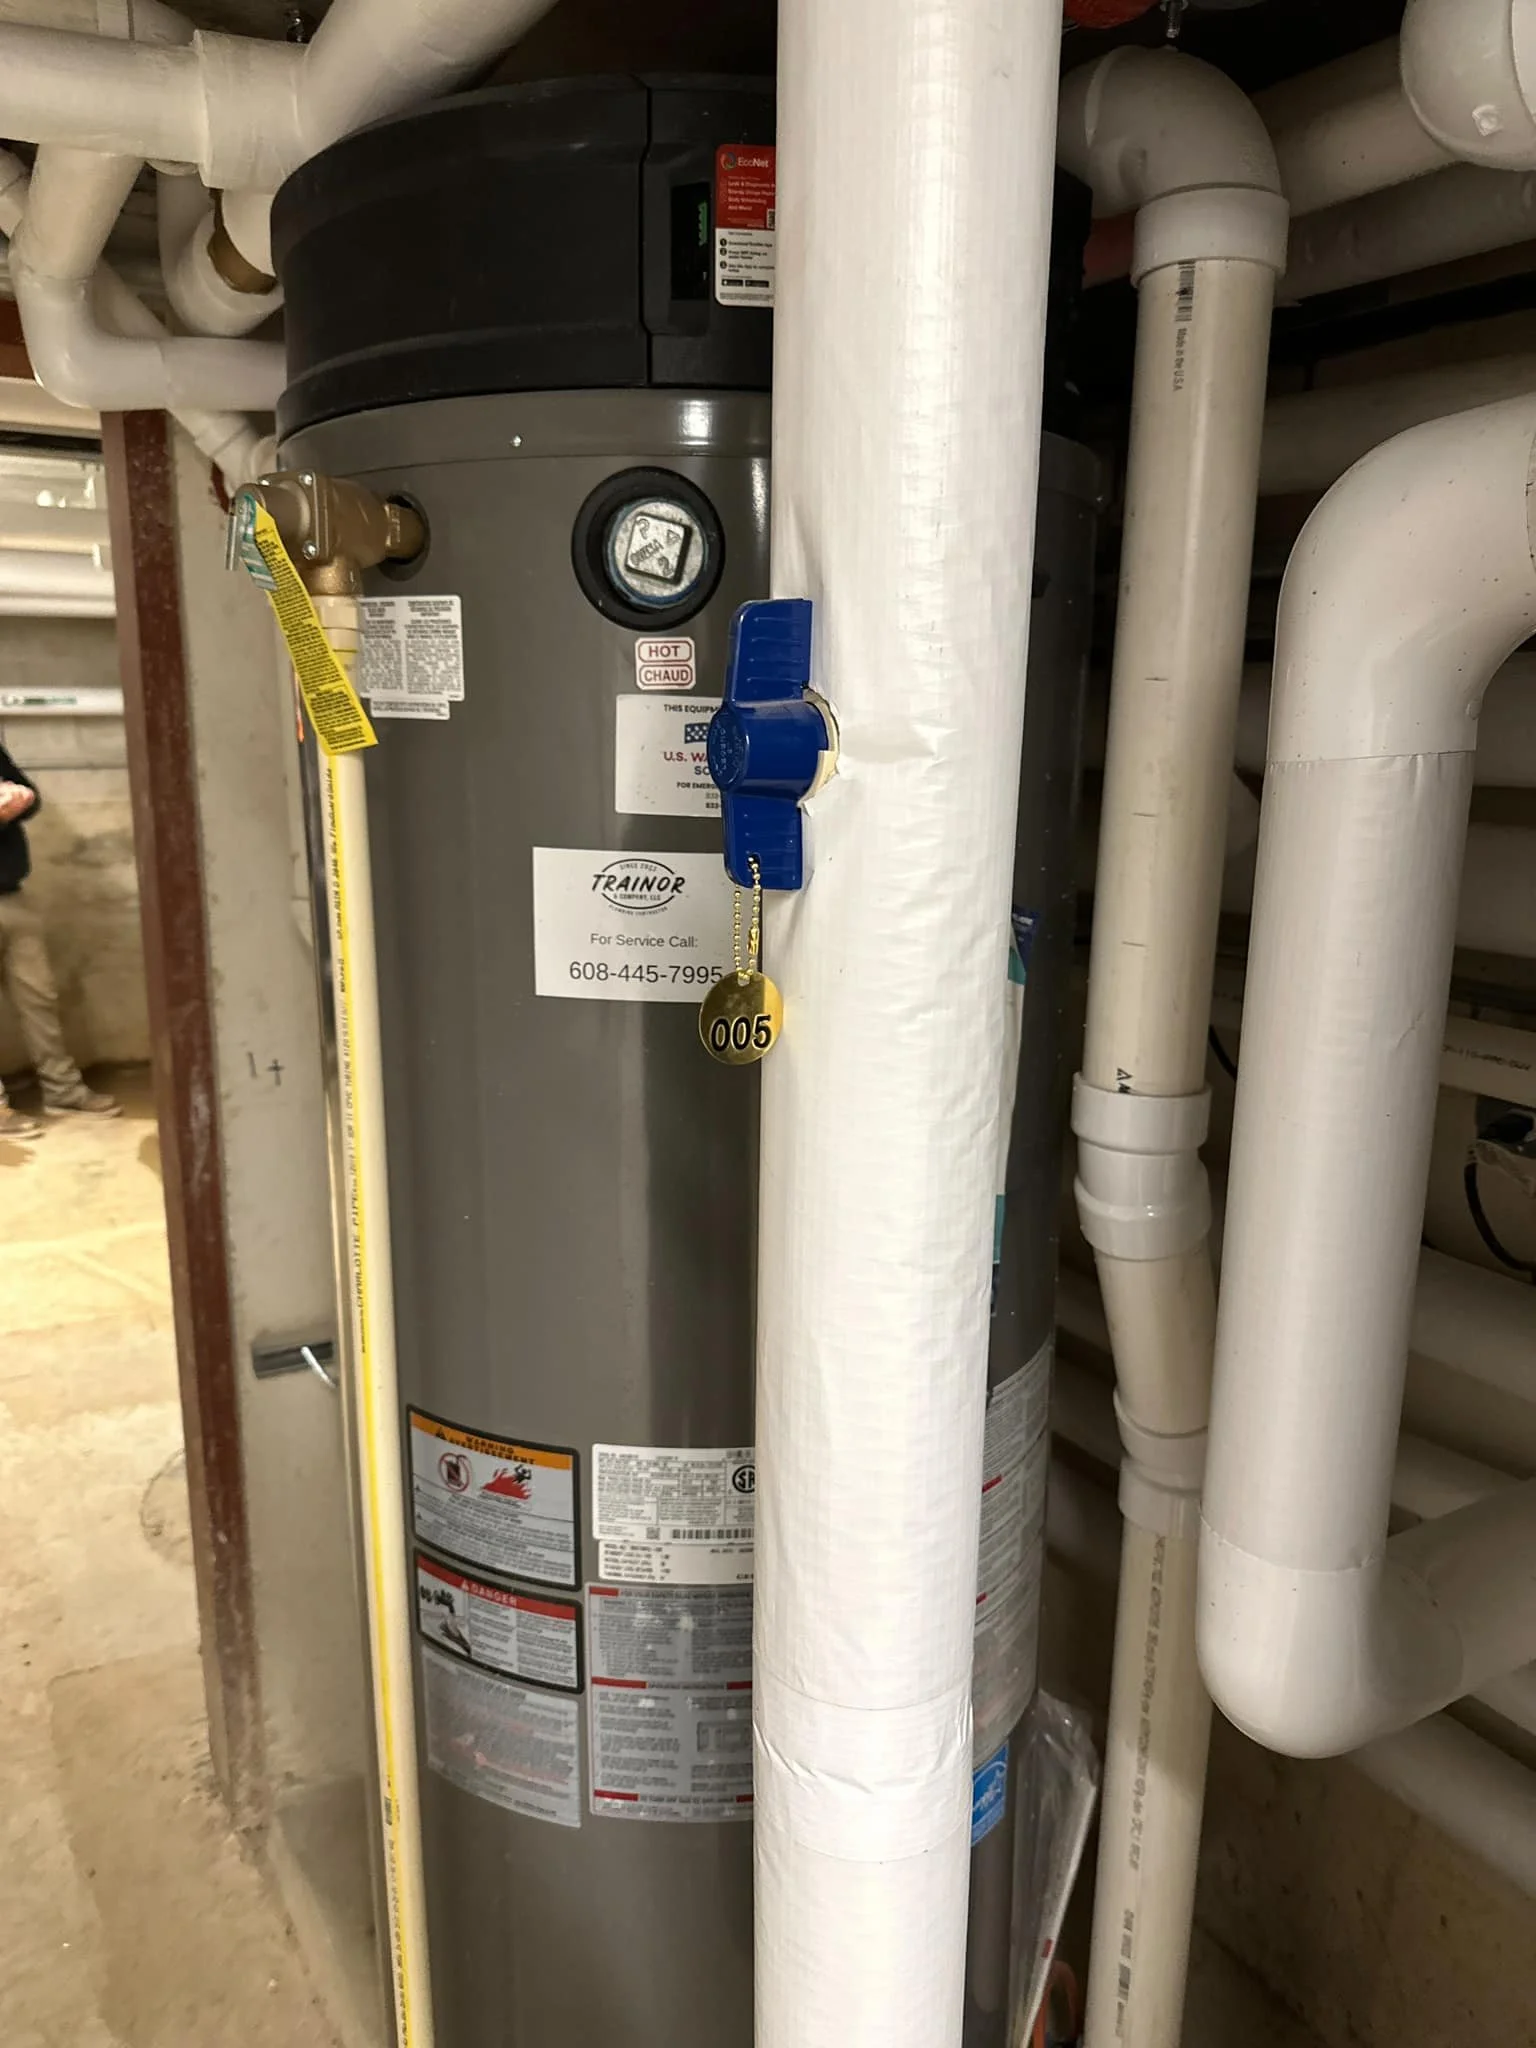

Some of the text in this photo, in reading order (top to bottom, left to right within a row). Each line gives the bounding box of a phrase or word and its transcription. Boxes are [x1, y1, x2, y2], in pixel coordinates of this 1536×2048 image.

[737, 157, 769, 169] EcoNet
[648, 645, 681, 658] HOT
[644, 669, 690, 682] CHAUD
[663, 703, 684, 713] THIS
[663, 751, 688, 762] U.S.
[676, 781, 691, 789] FOR
[591, 874, 686, 894] TRAINOR
[590, 933, 699, 948] For Service Call:
[569, 961, 724, 984] 608-445-7995
[709, 1013, 773, 1053] 005
[448, 1436, 536, 1465] AVERTISSEMENT
[465, 1435, 515, 1455] WARNING
[470, 1582, 518, 1604] DANGER
